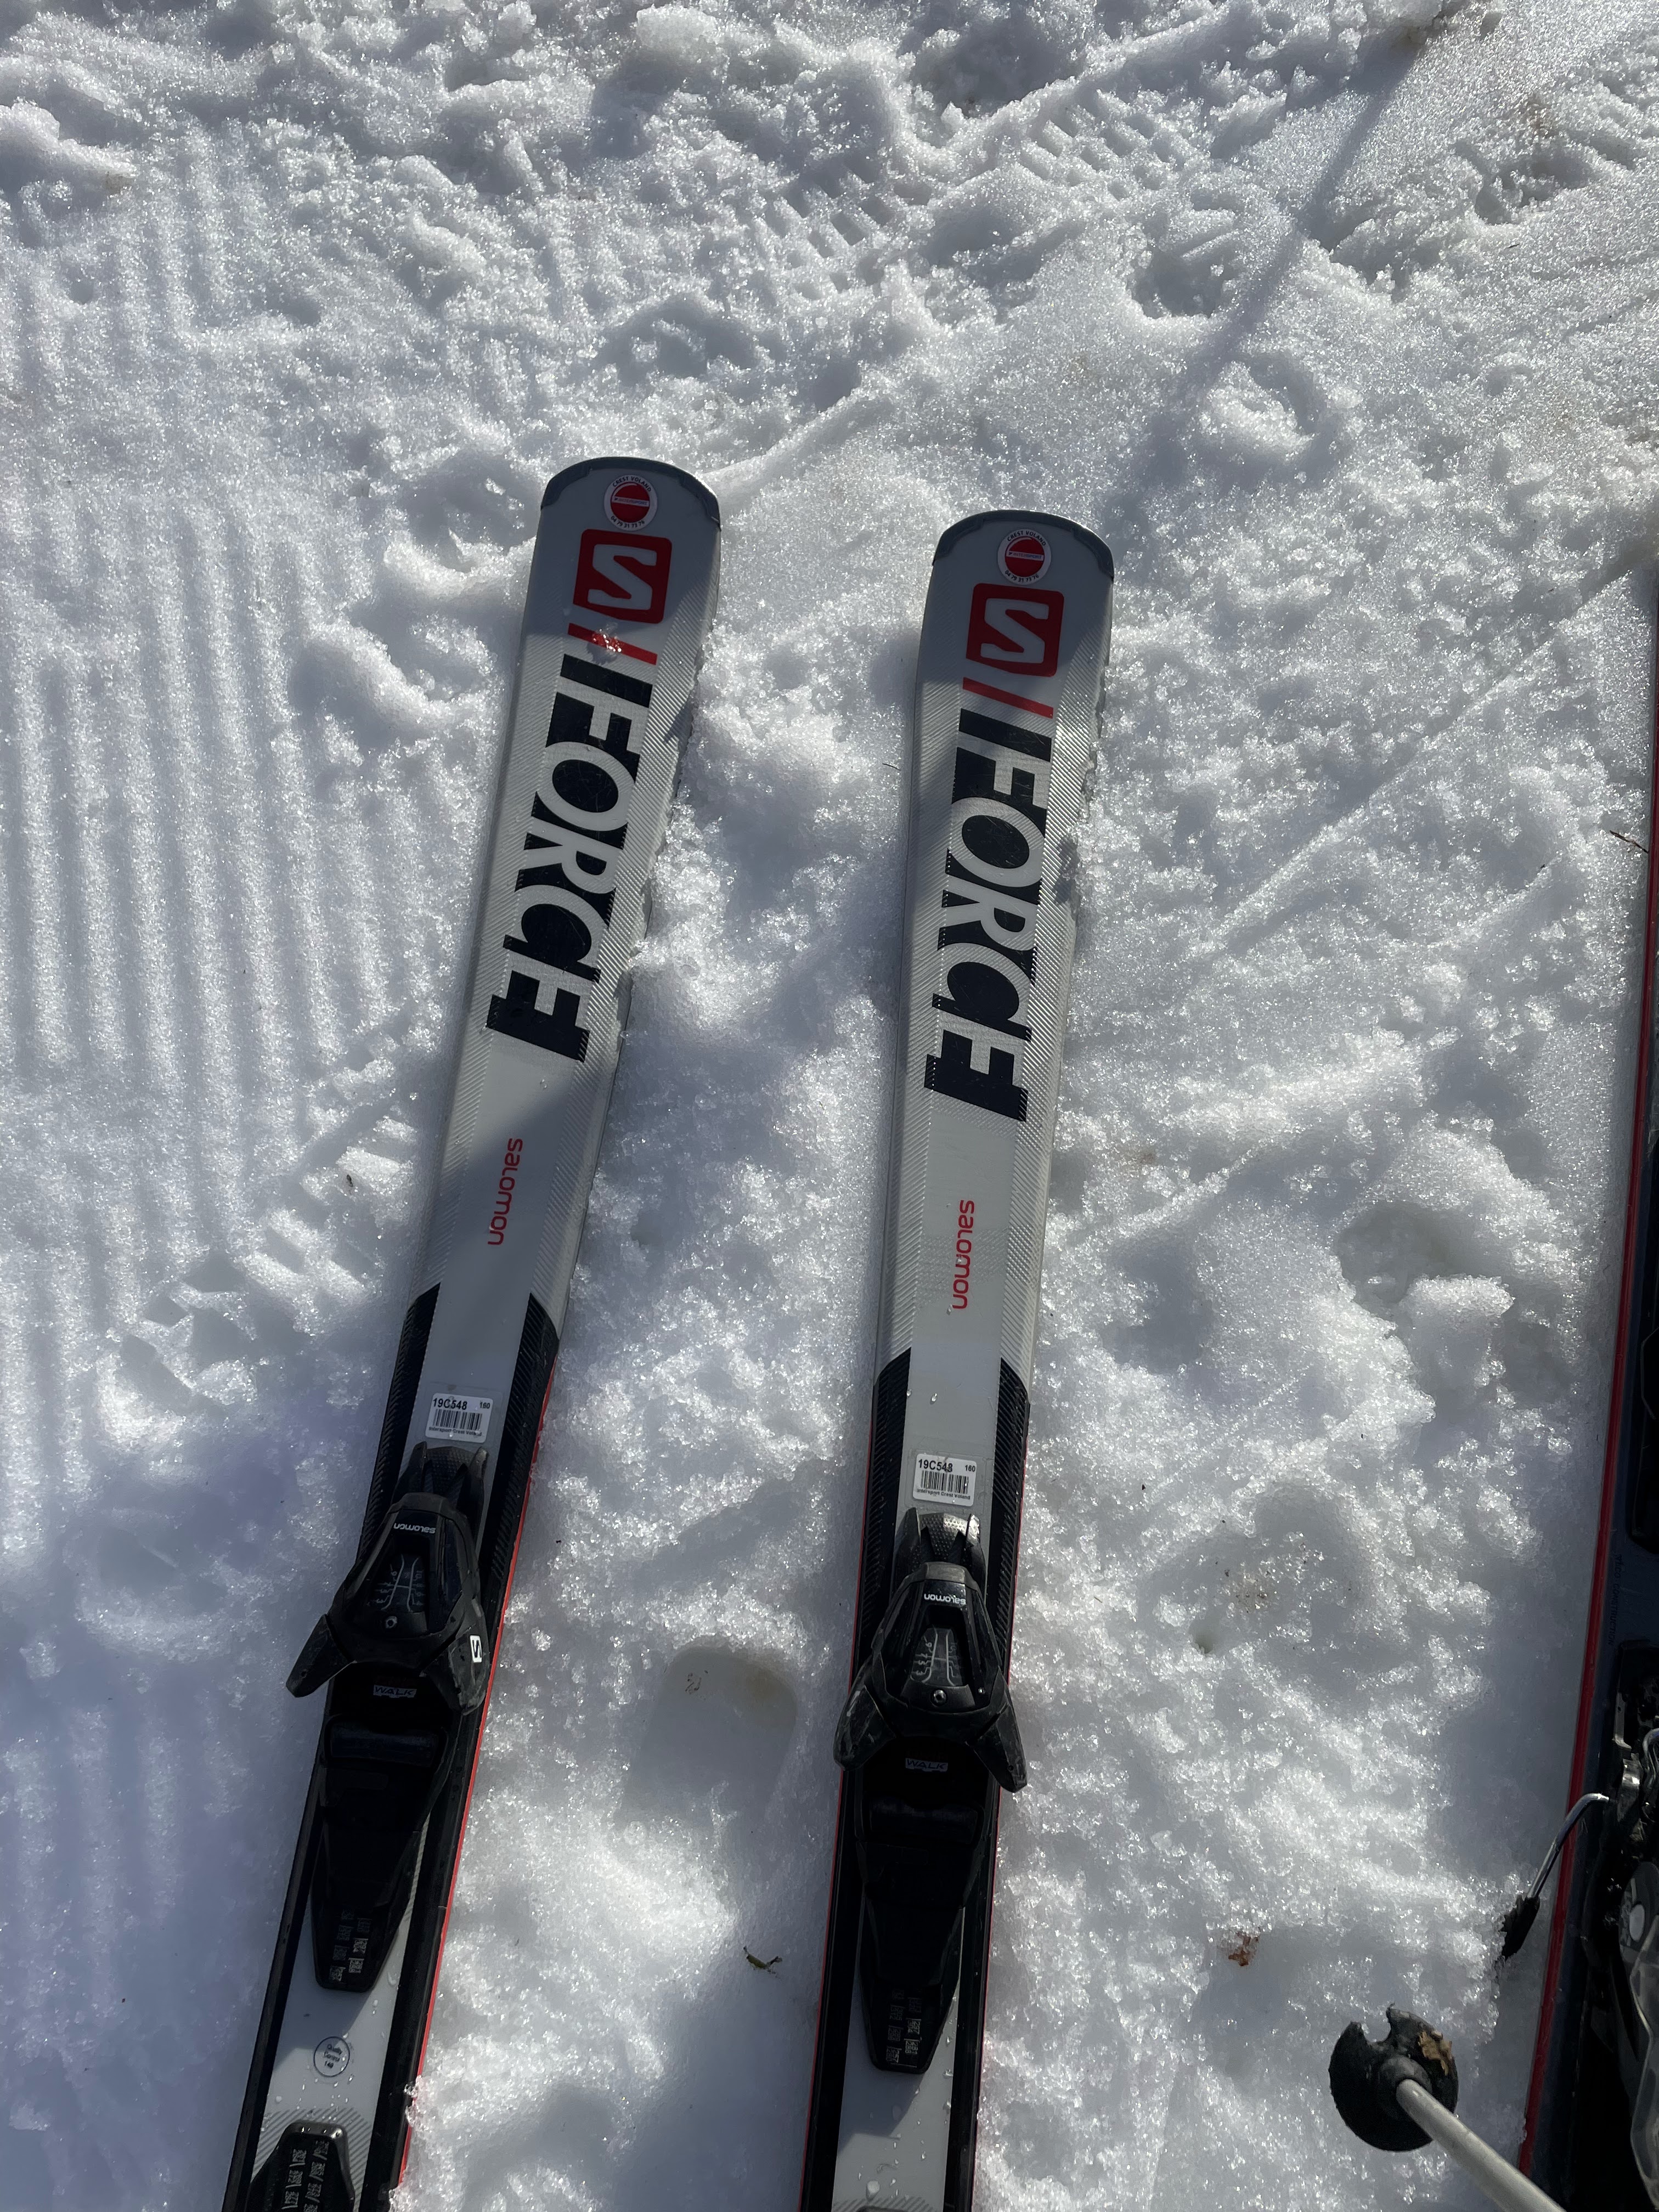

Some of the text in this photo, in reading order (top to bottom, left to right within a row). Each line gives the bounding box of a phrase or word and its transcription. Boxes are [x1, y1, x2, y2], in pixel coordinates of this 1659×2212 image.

[613, 476, 651, 492] CREST VOLAND
[1008, 531, 1046, 546] CREST VOLAND
[433, 1397, 467, 1410] 19C548
[918, 1459, 953, 1472] 19C548
[375, 1686, 413, 1695] WALK
[907, 1759, 946, 1769] WALK
